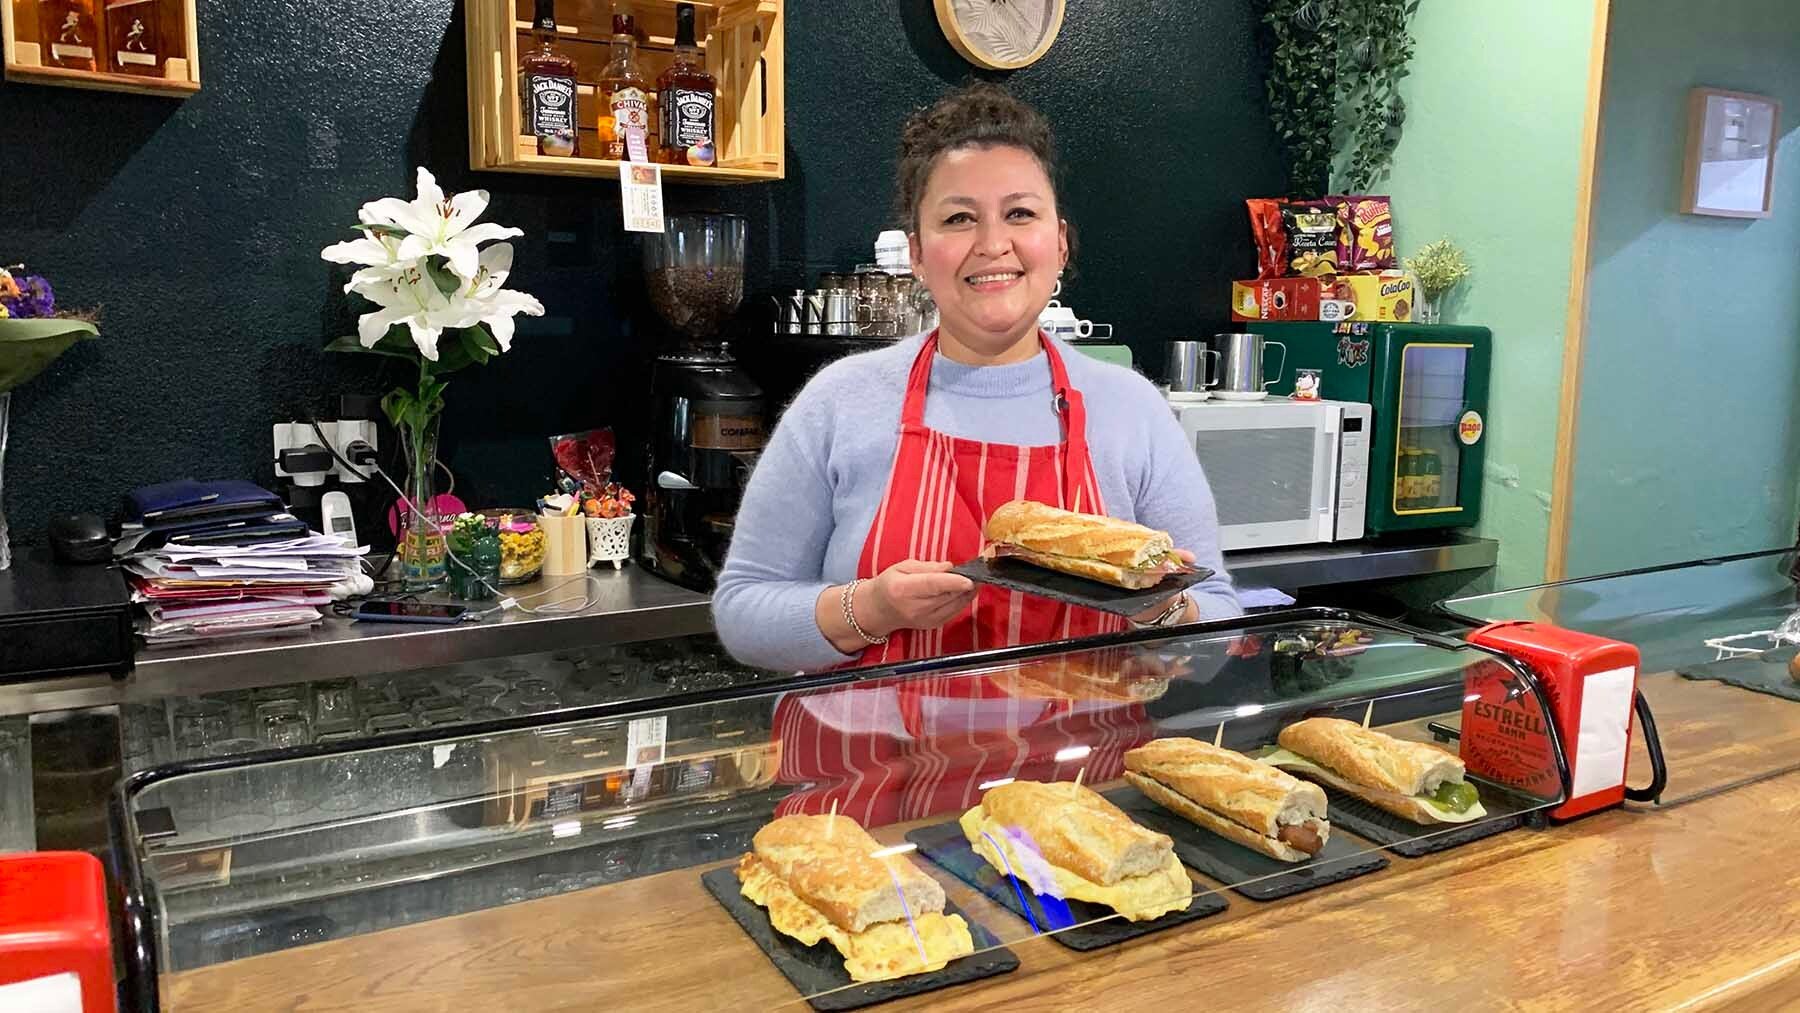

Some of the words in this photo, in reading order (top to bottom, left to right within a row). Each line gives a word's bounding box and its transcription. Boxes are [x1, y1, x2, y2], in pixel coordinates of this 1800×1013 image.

[533, 82, 549, 94] JACK
[676, 94, 690, 107] JACK
[681, 127, 708, 135] WHISKEY
[1381, 280, 1411, 297] ColaCao
